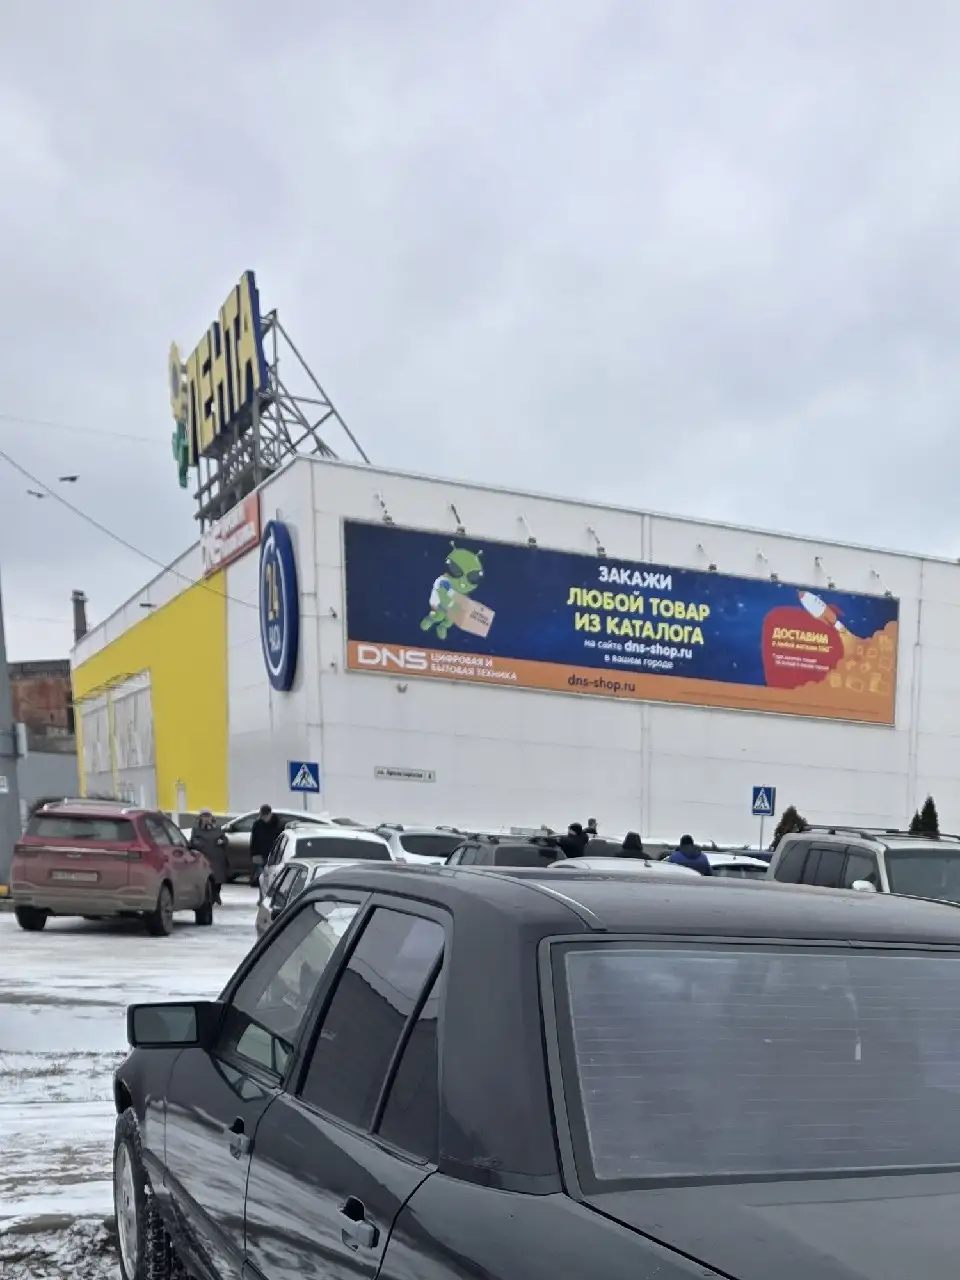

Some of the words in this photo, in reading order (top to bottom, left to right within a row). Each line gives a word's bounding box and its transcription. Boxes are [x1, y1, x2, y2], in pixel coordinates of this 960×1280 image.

[186, 270, 267, 466] ЛЕНТА
[598, 565, 672, 591] ЗАКАЖИ
[566, 586, 644, 614] ЛЮБОЙ
[649, 596, 711, 622] ТОВАР
[574, 611, 601, 633] ИЗ
[606, 615, 705, 645] КАТАЛОГА
[357, 643, 428, 670] DNS
[584, 639, 596, 649] на
[598, 640, 623, 651] сайте
[624, 640, 693, 660] dns-shop.ru
[604, 655, 610, 663] в
[643, 659, 674, 672] городе
[567, 674, 636, 693] dns-shop.ru
